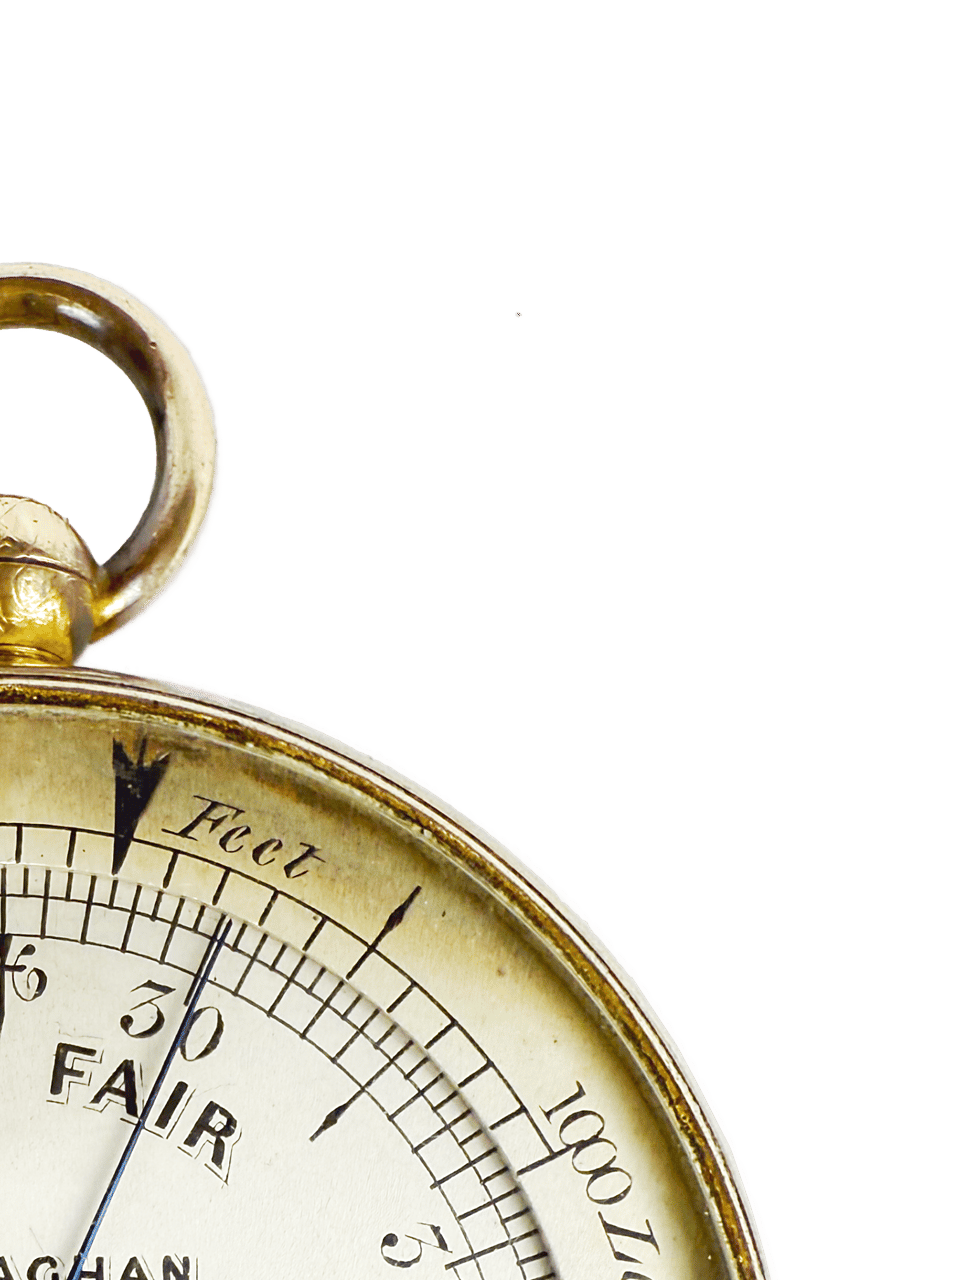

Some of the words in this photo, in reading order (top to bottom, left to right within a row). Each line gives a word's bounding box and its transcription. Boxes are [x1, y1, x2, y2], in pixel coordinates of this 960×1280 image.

[161, 793, 327, 880] Feet
[120, 979, 224, 1062] 30
[49, 1041, 244, 1180] FAIR
[539, 1080, 633, 1206] 1000
